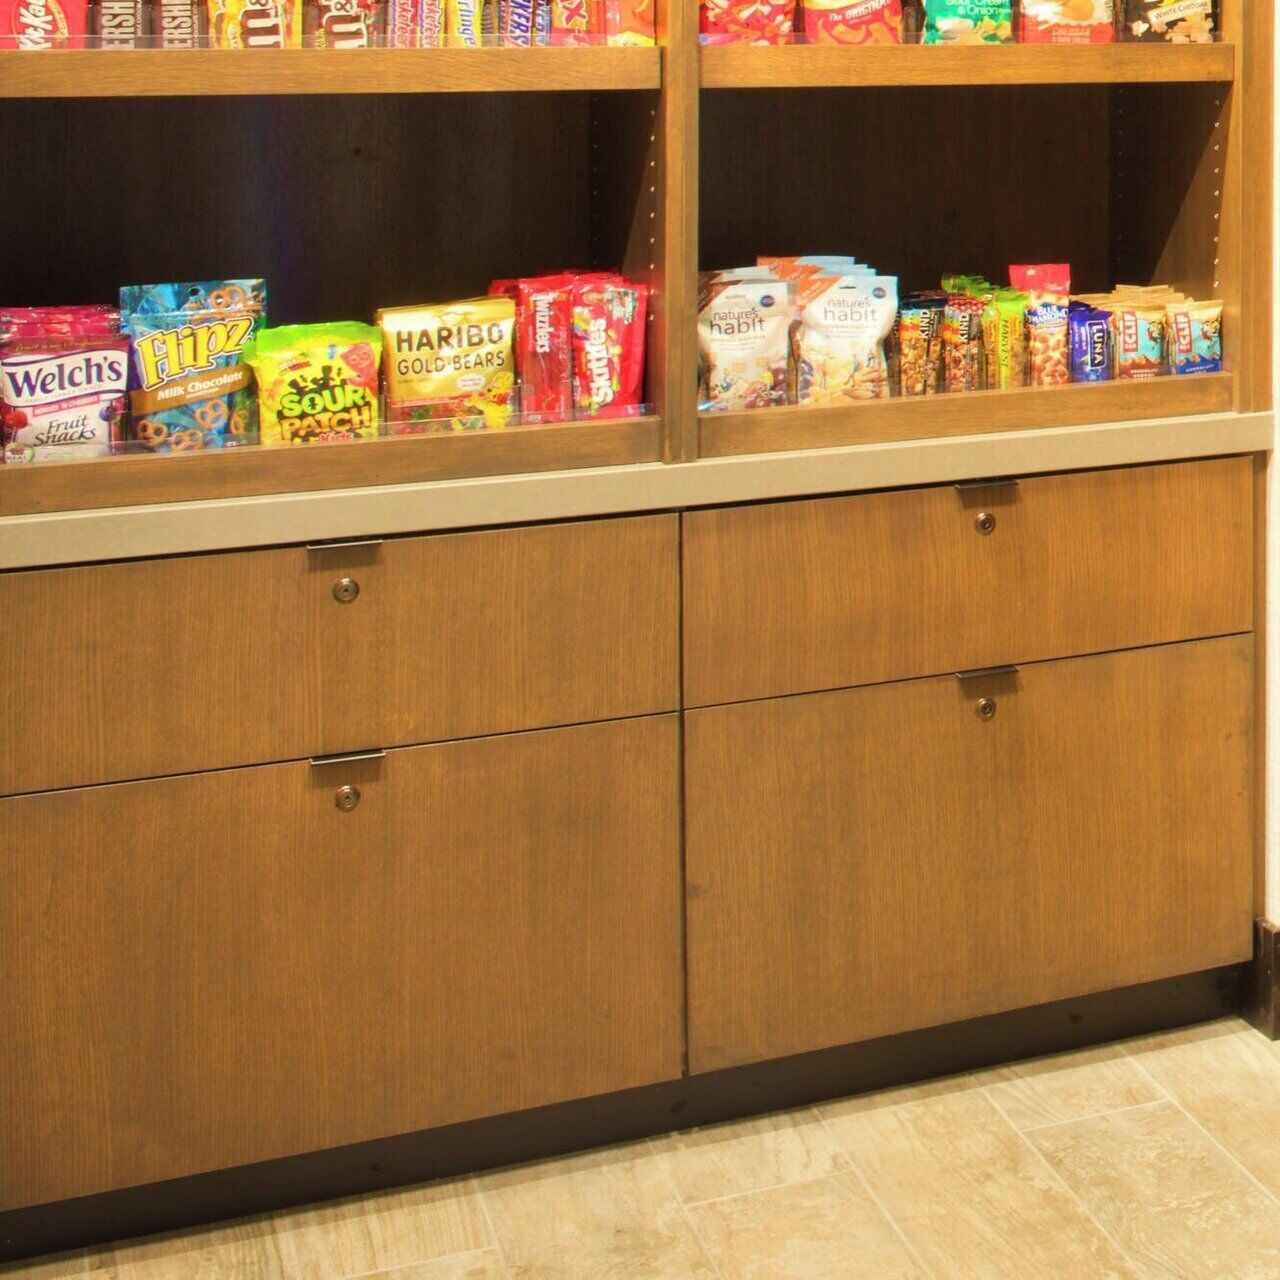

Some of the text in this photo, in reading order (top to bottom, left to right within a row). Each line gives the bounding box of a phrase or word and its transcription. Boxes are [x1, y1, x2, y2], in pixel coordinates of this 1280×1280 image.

[713, 307, 759, 321] nature's
[823, 307, 878, 322] habit
[827, 298, 871, 308] nature's
[396, 322, 504, 353] HARIBO
[710, 317, 766, 335] habit
[919, 309, 930, 339] KIND
[959, 313, 970, 343] KIND
[1123, 312, 1137, 345] CLIF
[1176, 313, 1191, 345] CLIF
[137, 318, 254, 391] Flipz
[1092, 325, 1104, 363] LUNA
[585, 318, 614, 403] Skittles
[7, 357, 123, 398] Welch's
[157, 371, 243, 400] Milk Chocolate
[280, 385, 367, 417] SOUR
[34, 427, 97, 447] Snacks
[48, 415, 88, 434] Fruit
[280, 407, 371, 440] PATCH
